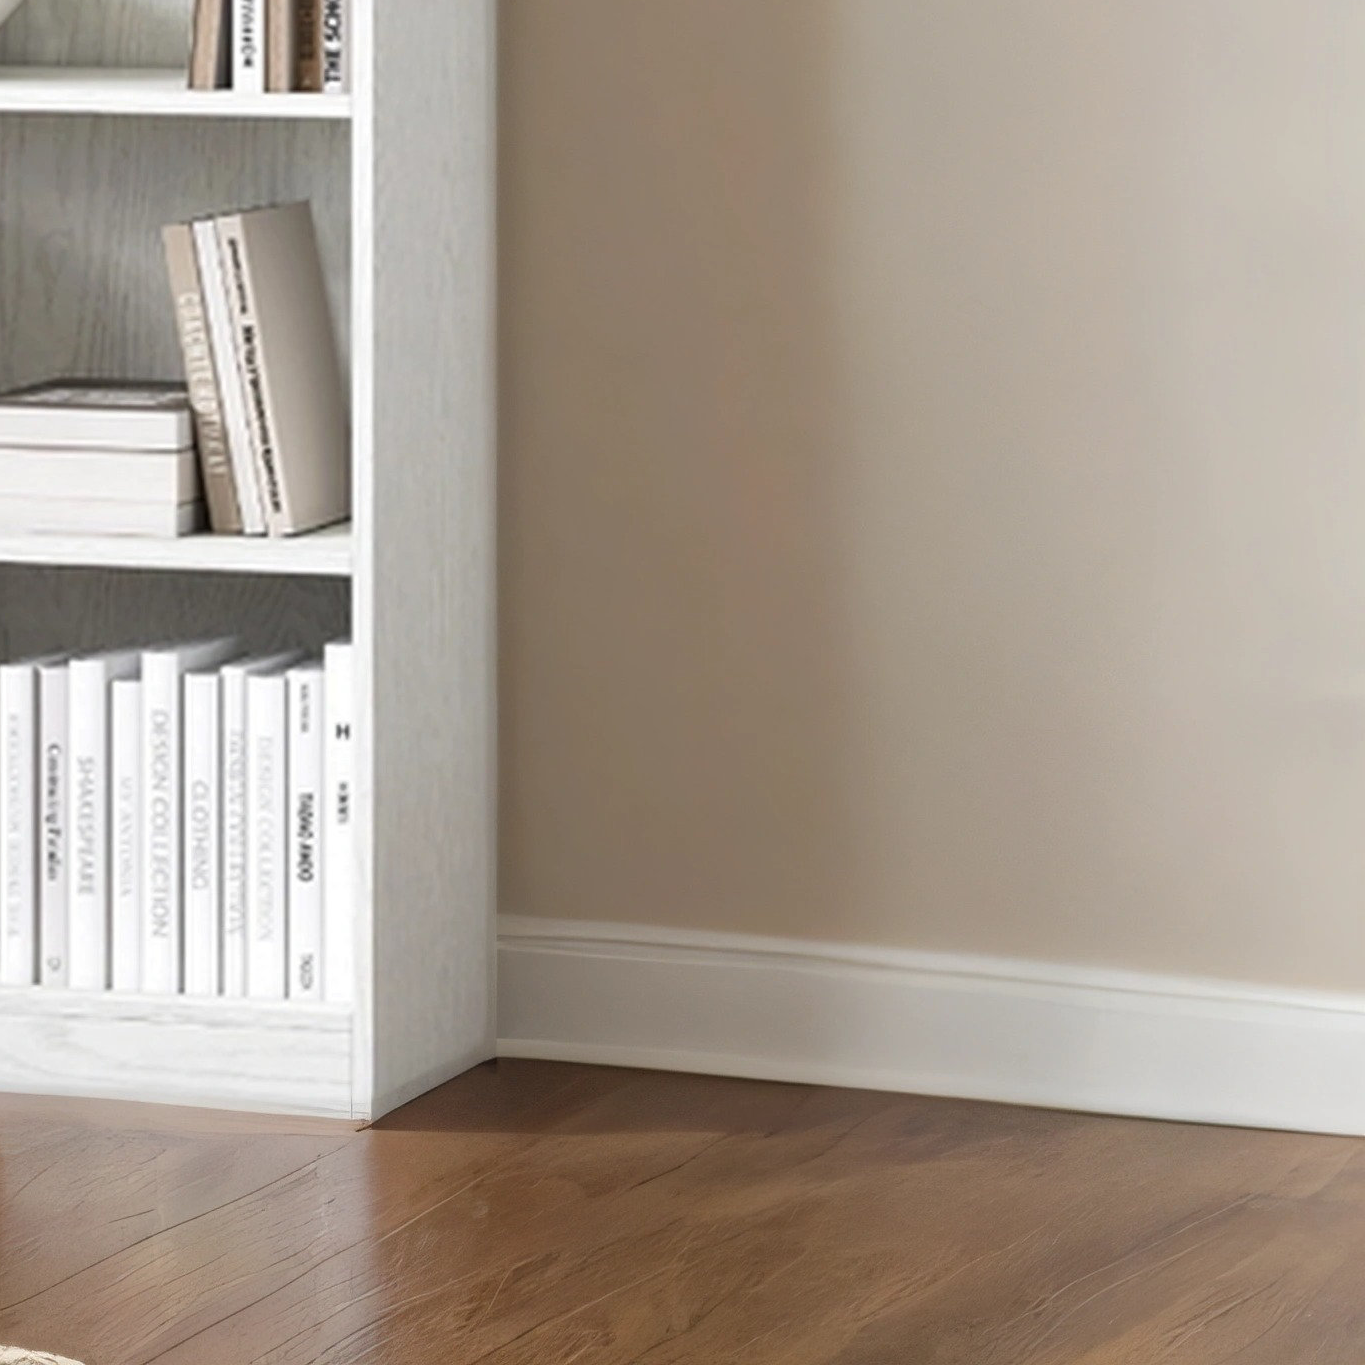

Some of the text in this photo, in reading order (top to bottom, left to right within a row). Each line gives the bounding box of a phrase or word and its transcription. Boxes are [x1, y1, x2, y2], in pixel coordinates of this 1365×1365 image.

[324, 50, 342, 83] THE
[76, 755, 95, 895] SHAKESPEARE
[150, 709, 169, 938] DESIGN COLLECTION
[191, 779, 210, 890] CLOTHING
